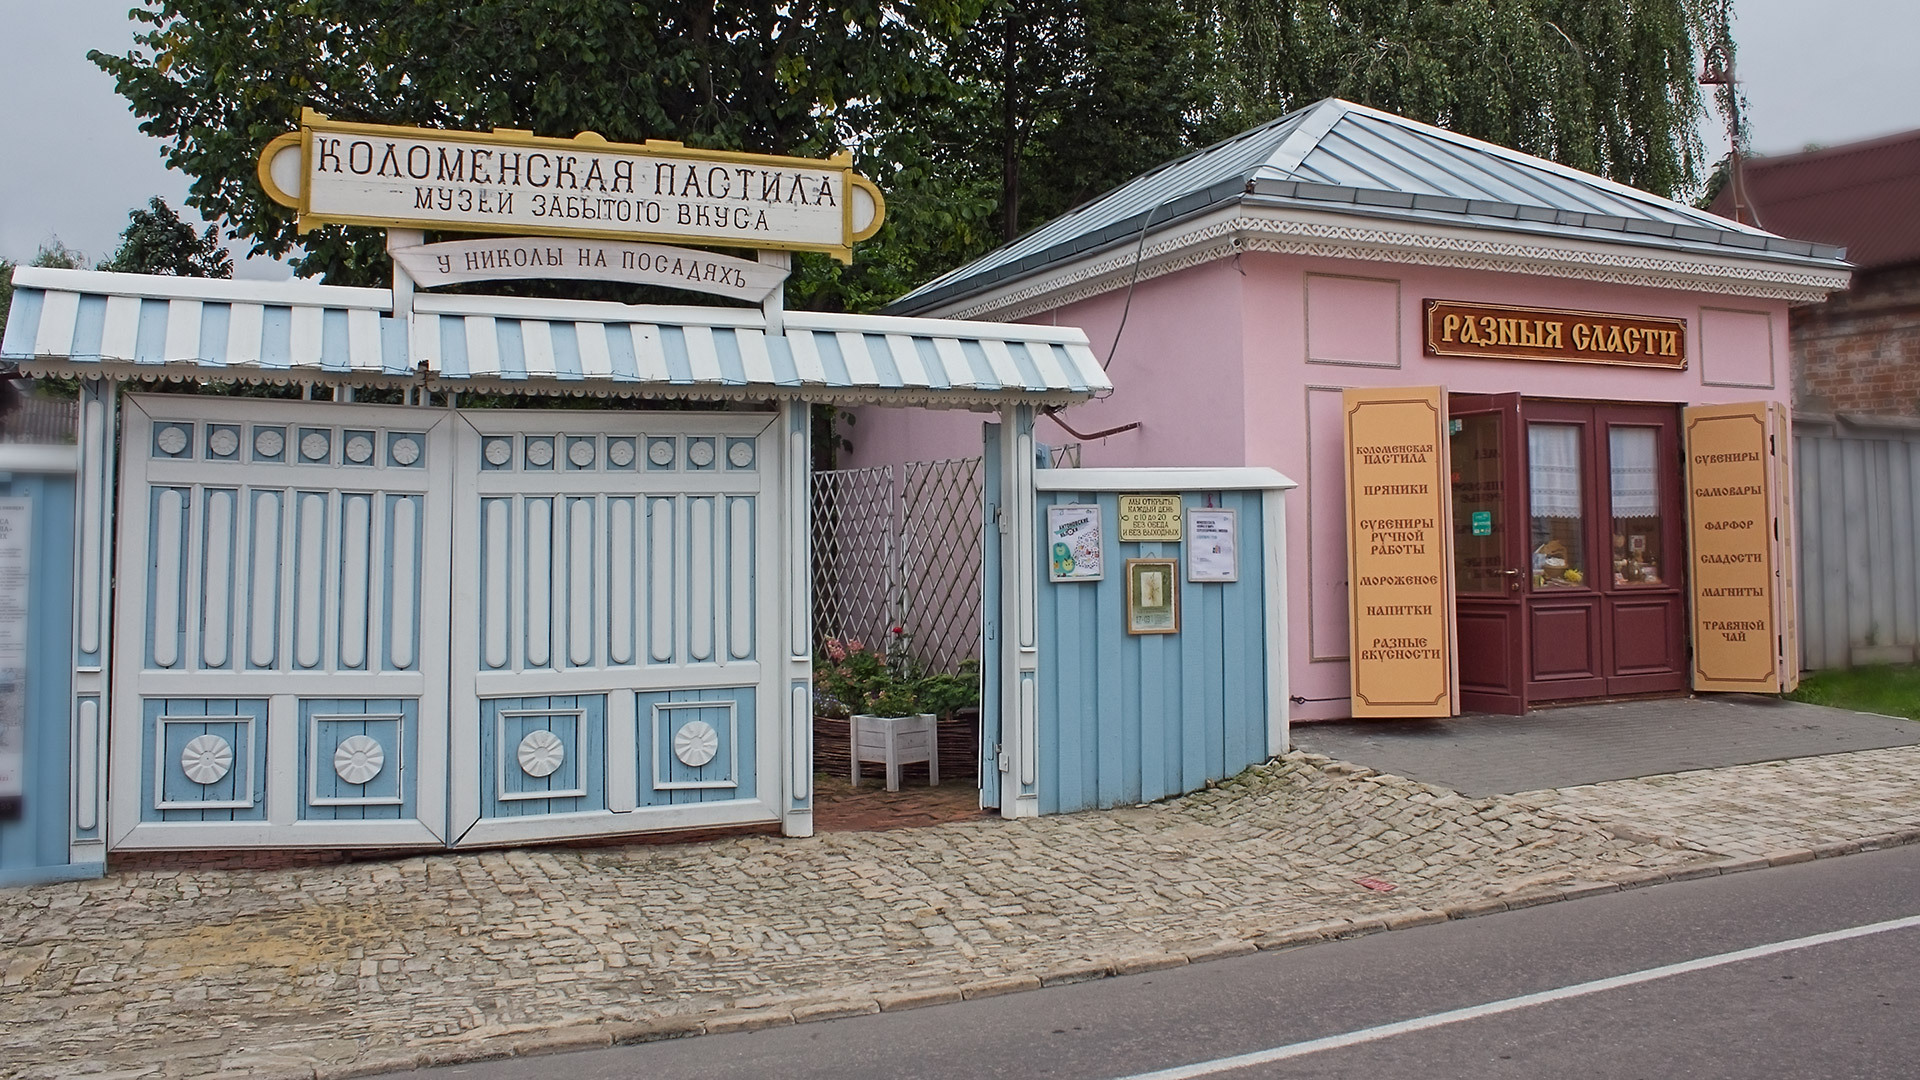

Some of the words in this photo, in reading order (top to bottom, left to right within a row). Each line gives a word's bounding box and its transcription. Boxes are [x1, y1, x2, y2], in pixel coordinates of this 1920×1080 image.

[317, 138, 634, 194] КОЛОМЕНСКАЯ
[653, 162, 837, 207] ПАСТИЛА
[531, 193, 662, 225] ЗАБЫТОГО
[677, 204, 770, 232] ВКУСА
[437, 254, 452, 274] У
[465, 248, 564, 270] НИКОЛЫ
[577, 248, 608, 268] НА
[621, 250, 747, 289] ПОСАДЯХЪ
[1442, 314, 1564, 349] РАЗНЫЯ
[1572, 323, 1678, 357] СЛАСТИ
[1356, 444, 1433, 455] КОЛОМЕНСКАЯ
[1364, 453, 1427, 465] ПАСТИЛА
[1694, 451, 1760, 466] СУВЕНИРЫ
[1364, 484, 1428, 496] ПРЯНИКИ
[1695, 485, 1762, 498] САМОВАРЫ
[1360, 518, 1434, 532] СУВЕНИРЫ
[1704, 520, 1754, 531] ФАРФОР
[1371, 530, 1424, 544] РУЧНОЙ
[1370, 544, 1425, 555] РАБОТЫ
[1700, 553, 1762, 565] СЛАДОСТИ
[1360, 575, 1438, 586] МОРОЖЕНОЕ
[1701, 587, 1763, 597] МАГНИТЫ
[1367, 605, 1432, 616] НАПИТКИ
[1702, 620, 1764, 631] ТРАВЯНОЙ
[1721, 631, 1746, 642] ЧАЙ
[1373, 637, 1428, 650] РАЗНЫЕ
[1361, 649, 1440, 662] ВКУСНОСТИ
